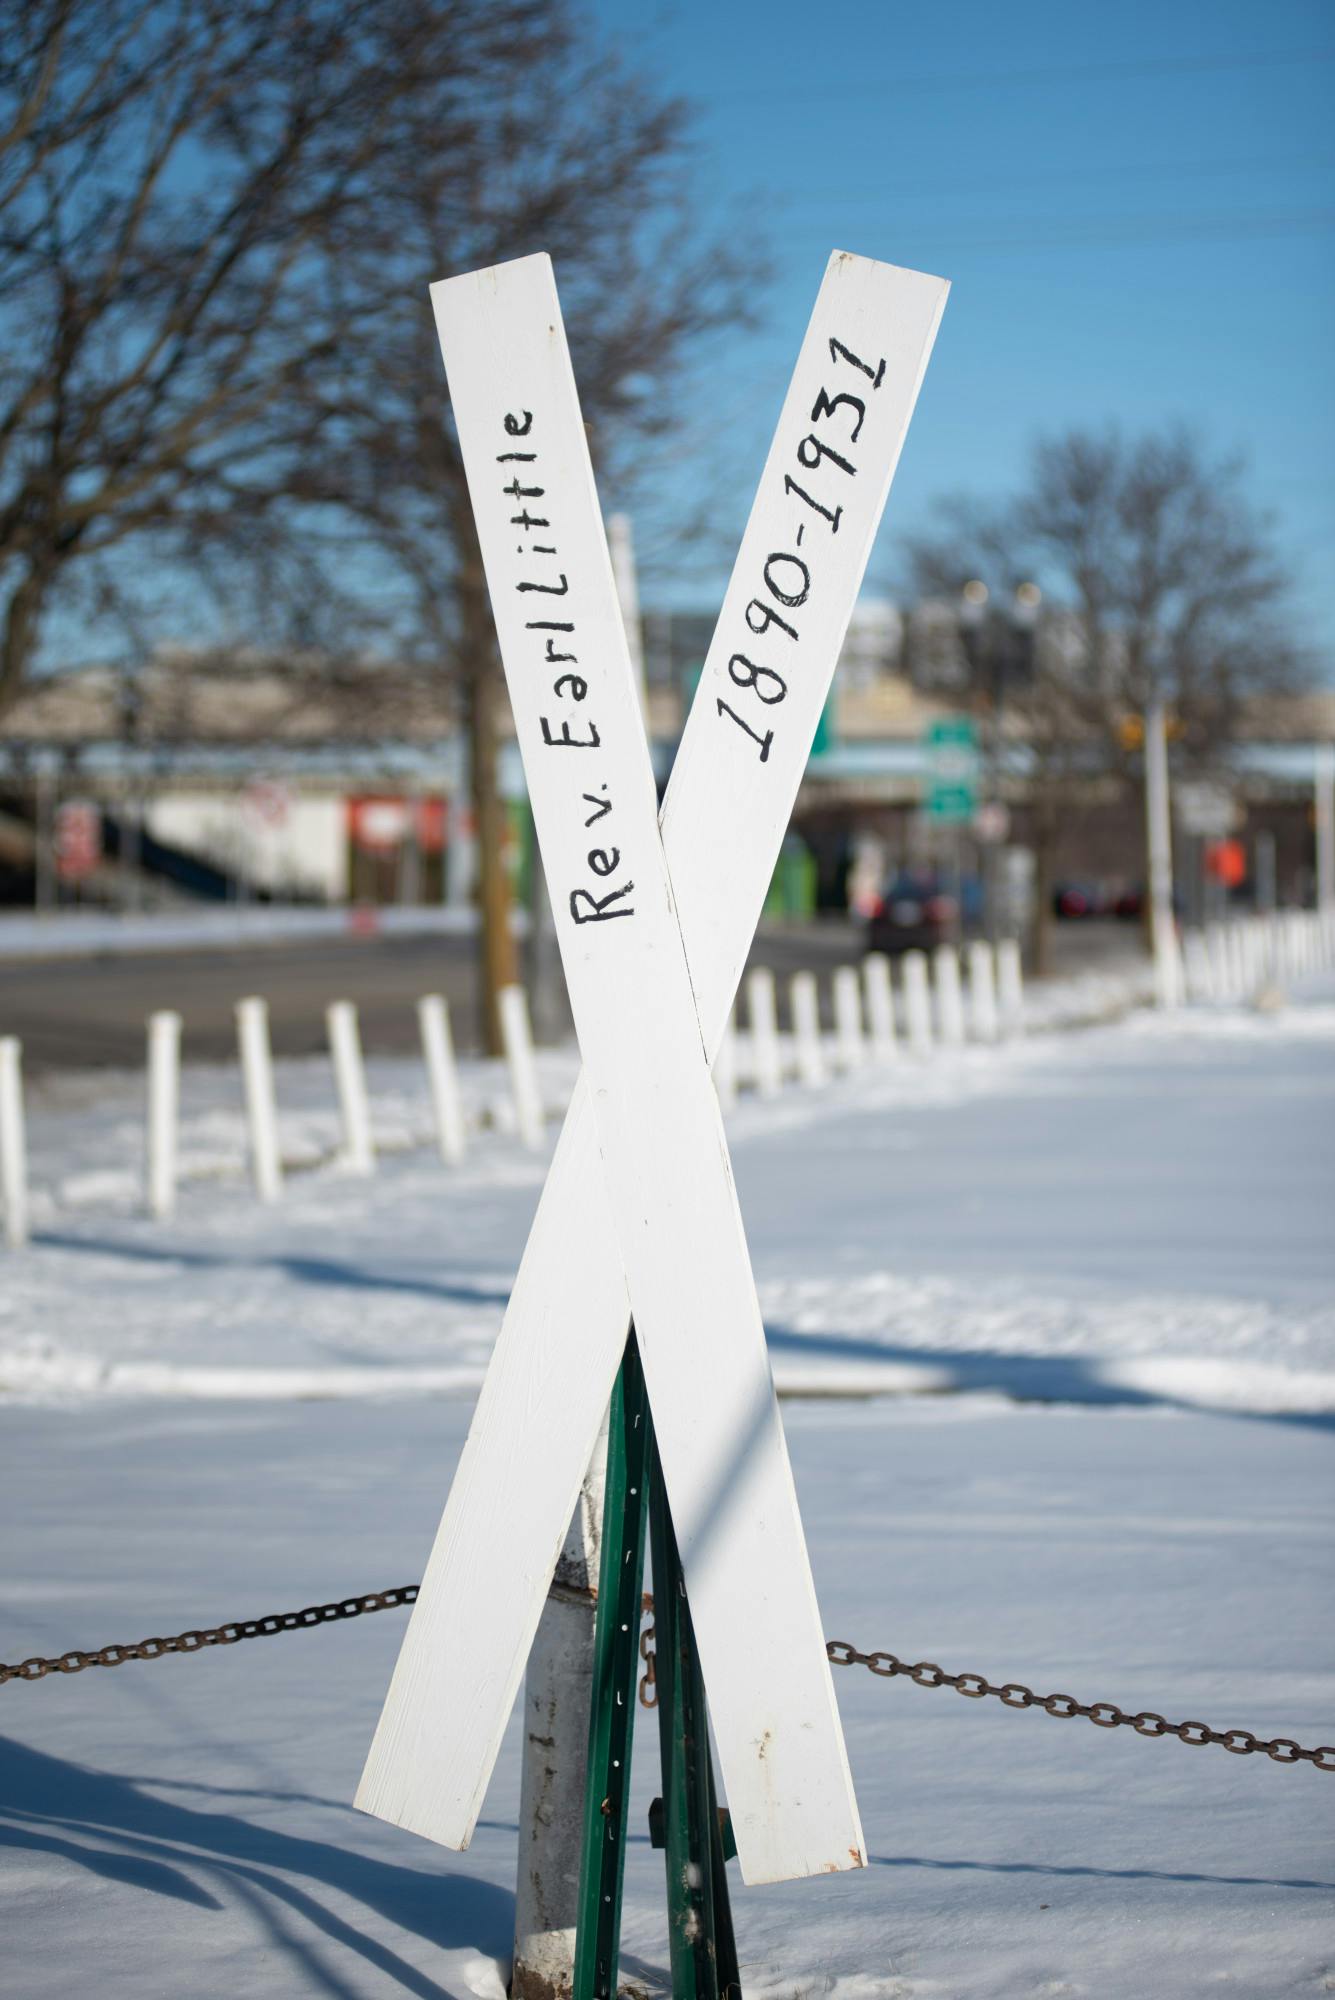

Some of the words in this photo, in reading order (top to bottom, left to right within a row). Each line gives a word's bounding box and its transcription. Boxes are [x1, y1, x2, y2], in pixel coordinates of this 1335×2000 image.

[496, 408, 570, 597] Little
[716, 337, 886, 763] 1890-1931
[525, 621, 601, 749] Earl
[570, 783, 636, 926] Rev.
